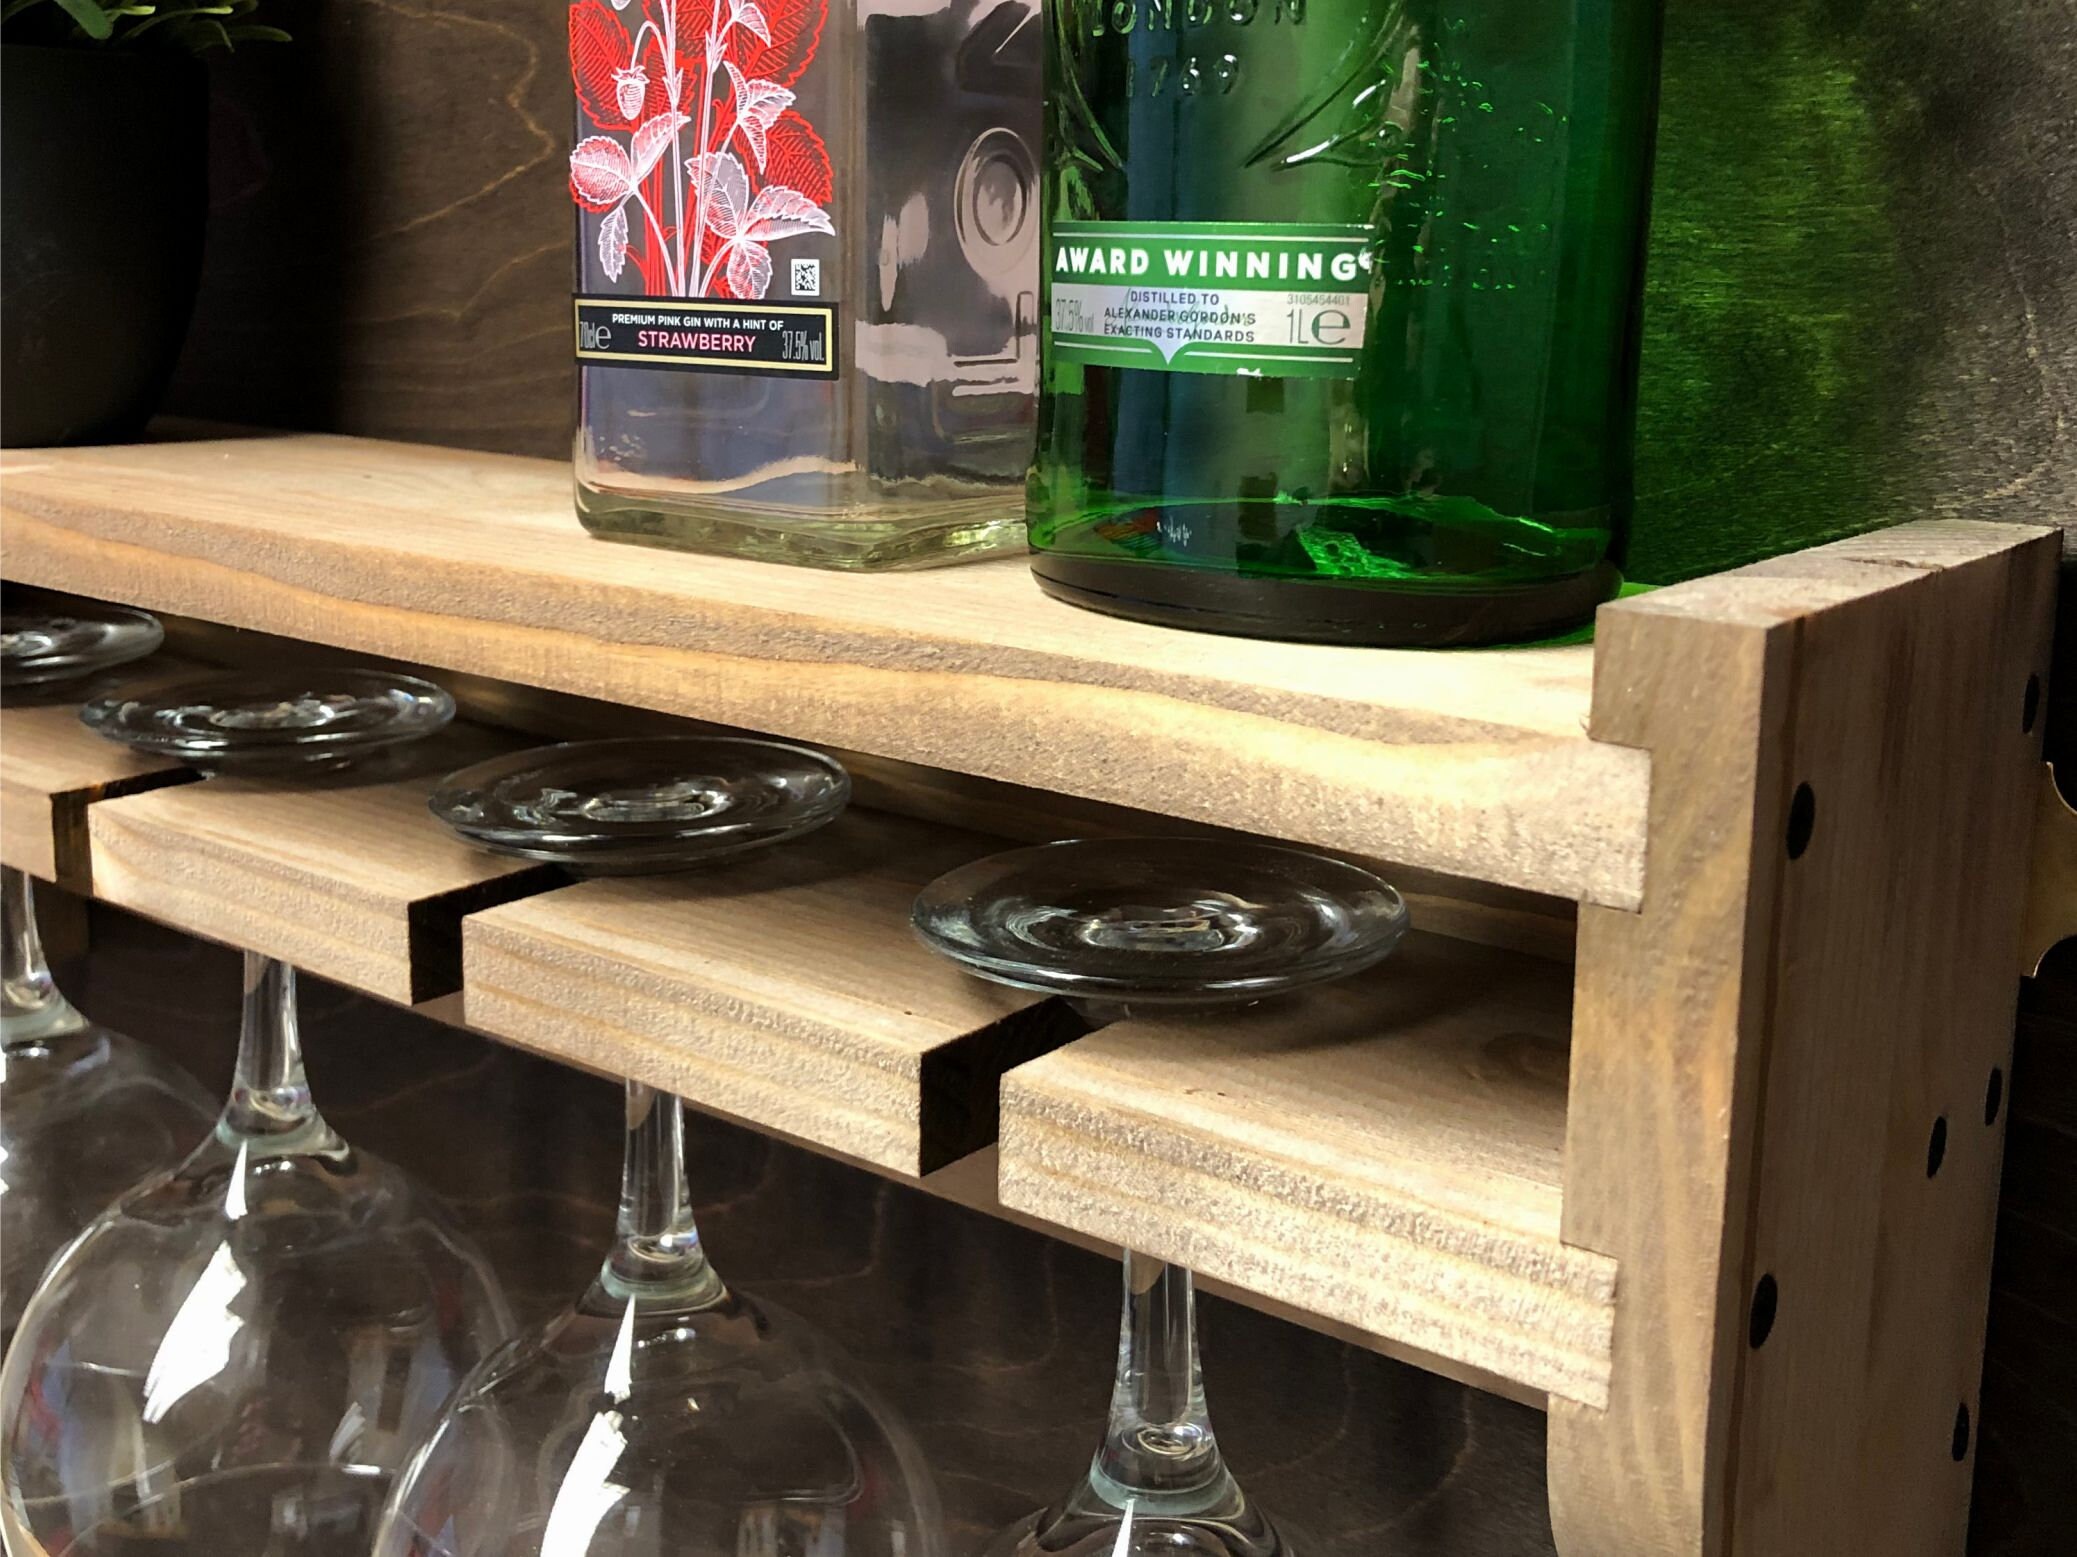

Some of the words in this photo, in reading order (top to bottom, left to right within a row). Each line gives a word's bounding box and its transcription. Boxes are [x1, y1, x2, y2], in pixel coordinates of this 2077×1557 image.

[1055, 247, 1149, 275] AWARD
[1164, 250, 1357, 281] WINNING
[1130, 290, 1196, 305] DISTILLED
[1201, 293, 1219, 305] TO
[612, 313, 656, 325] PREMIUM
[657, 315, 681, 326] PINK
[683, 316, 701, 327] GIN
[703, 318, 731, 329] WITH
[732, 319, 741, 329] A
[742, 319, 767, 331] HINT
[768, 320, 784, 331] OF
[1104, 307, 1175, 322] ALEXANDER
[1179, 310, 1256, 325] GORDON'S
[638, 330, 756, 353] STRAWBERRY
[1104, 322, 1162, 338] EXACTING
[1166, 327, 1255, 342] STANDARDS
